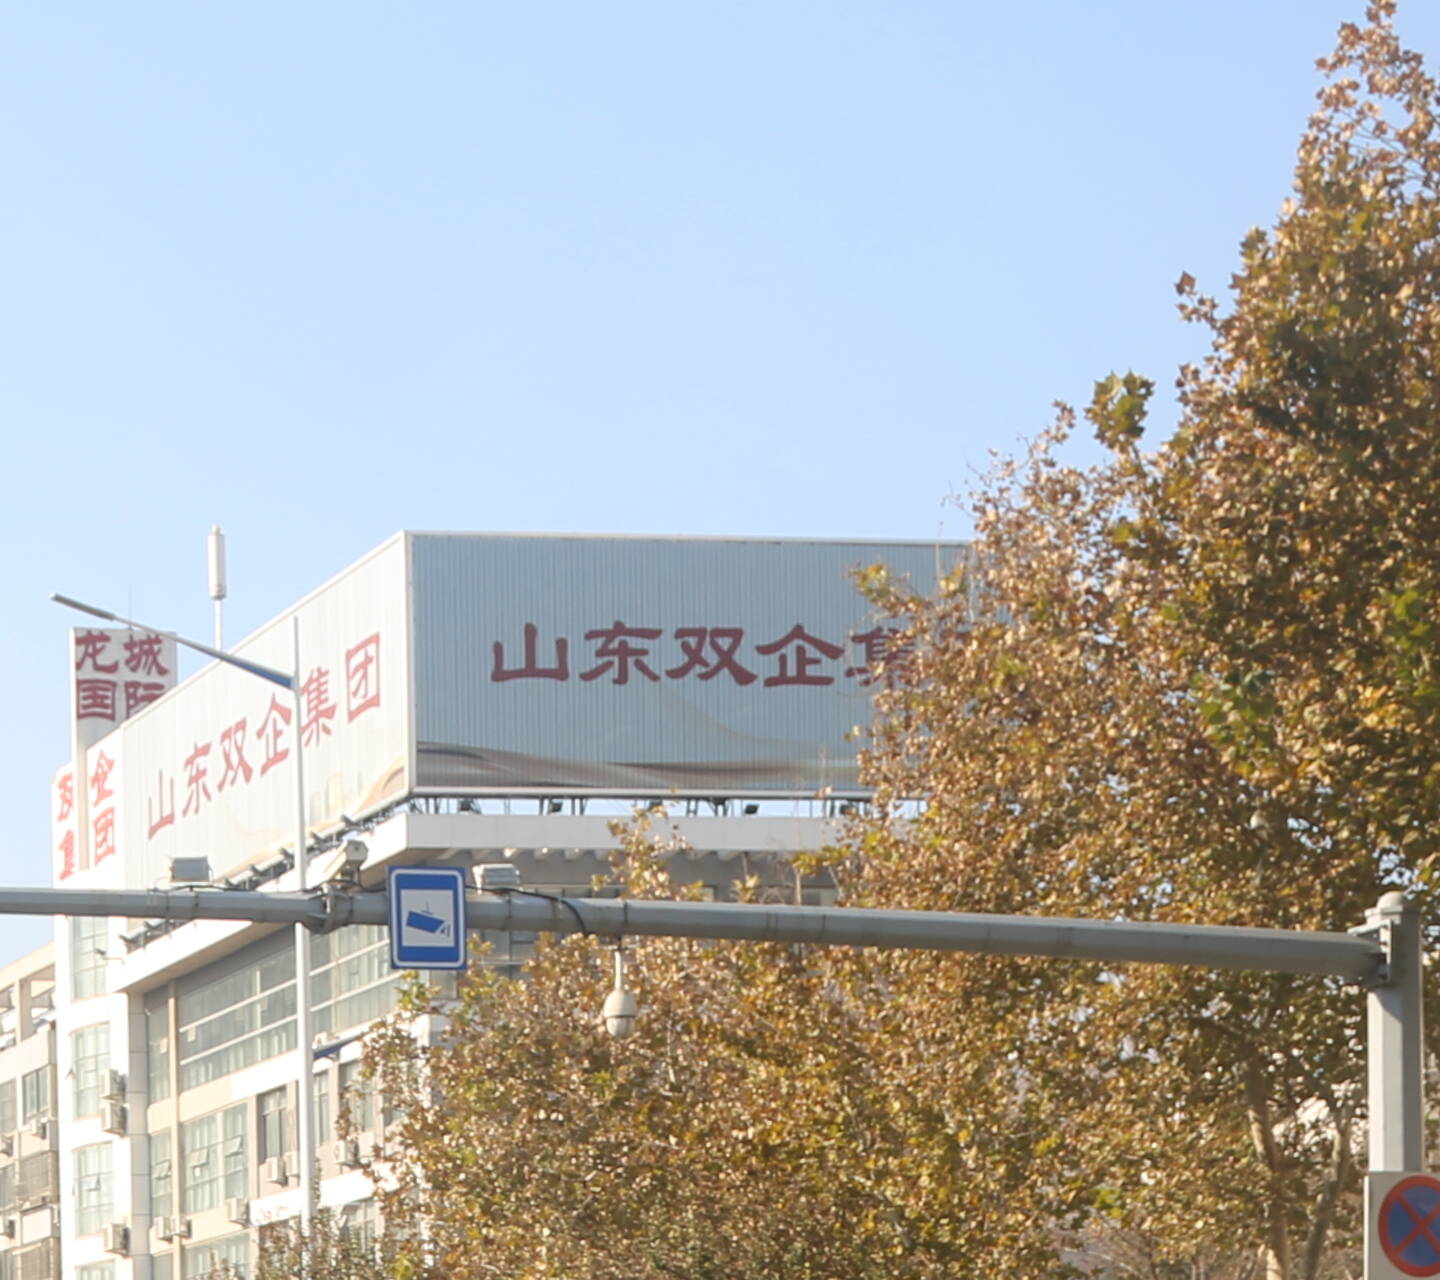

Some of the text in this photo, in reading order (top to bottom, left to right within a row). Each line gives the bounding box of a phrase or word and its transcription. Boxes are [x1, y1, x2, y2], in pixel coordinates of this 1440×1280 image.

[76, 630, 169, 676] 龙城
[148, 633, 381, 840] 山东双企集团
